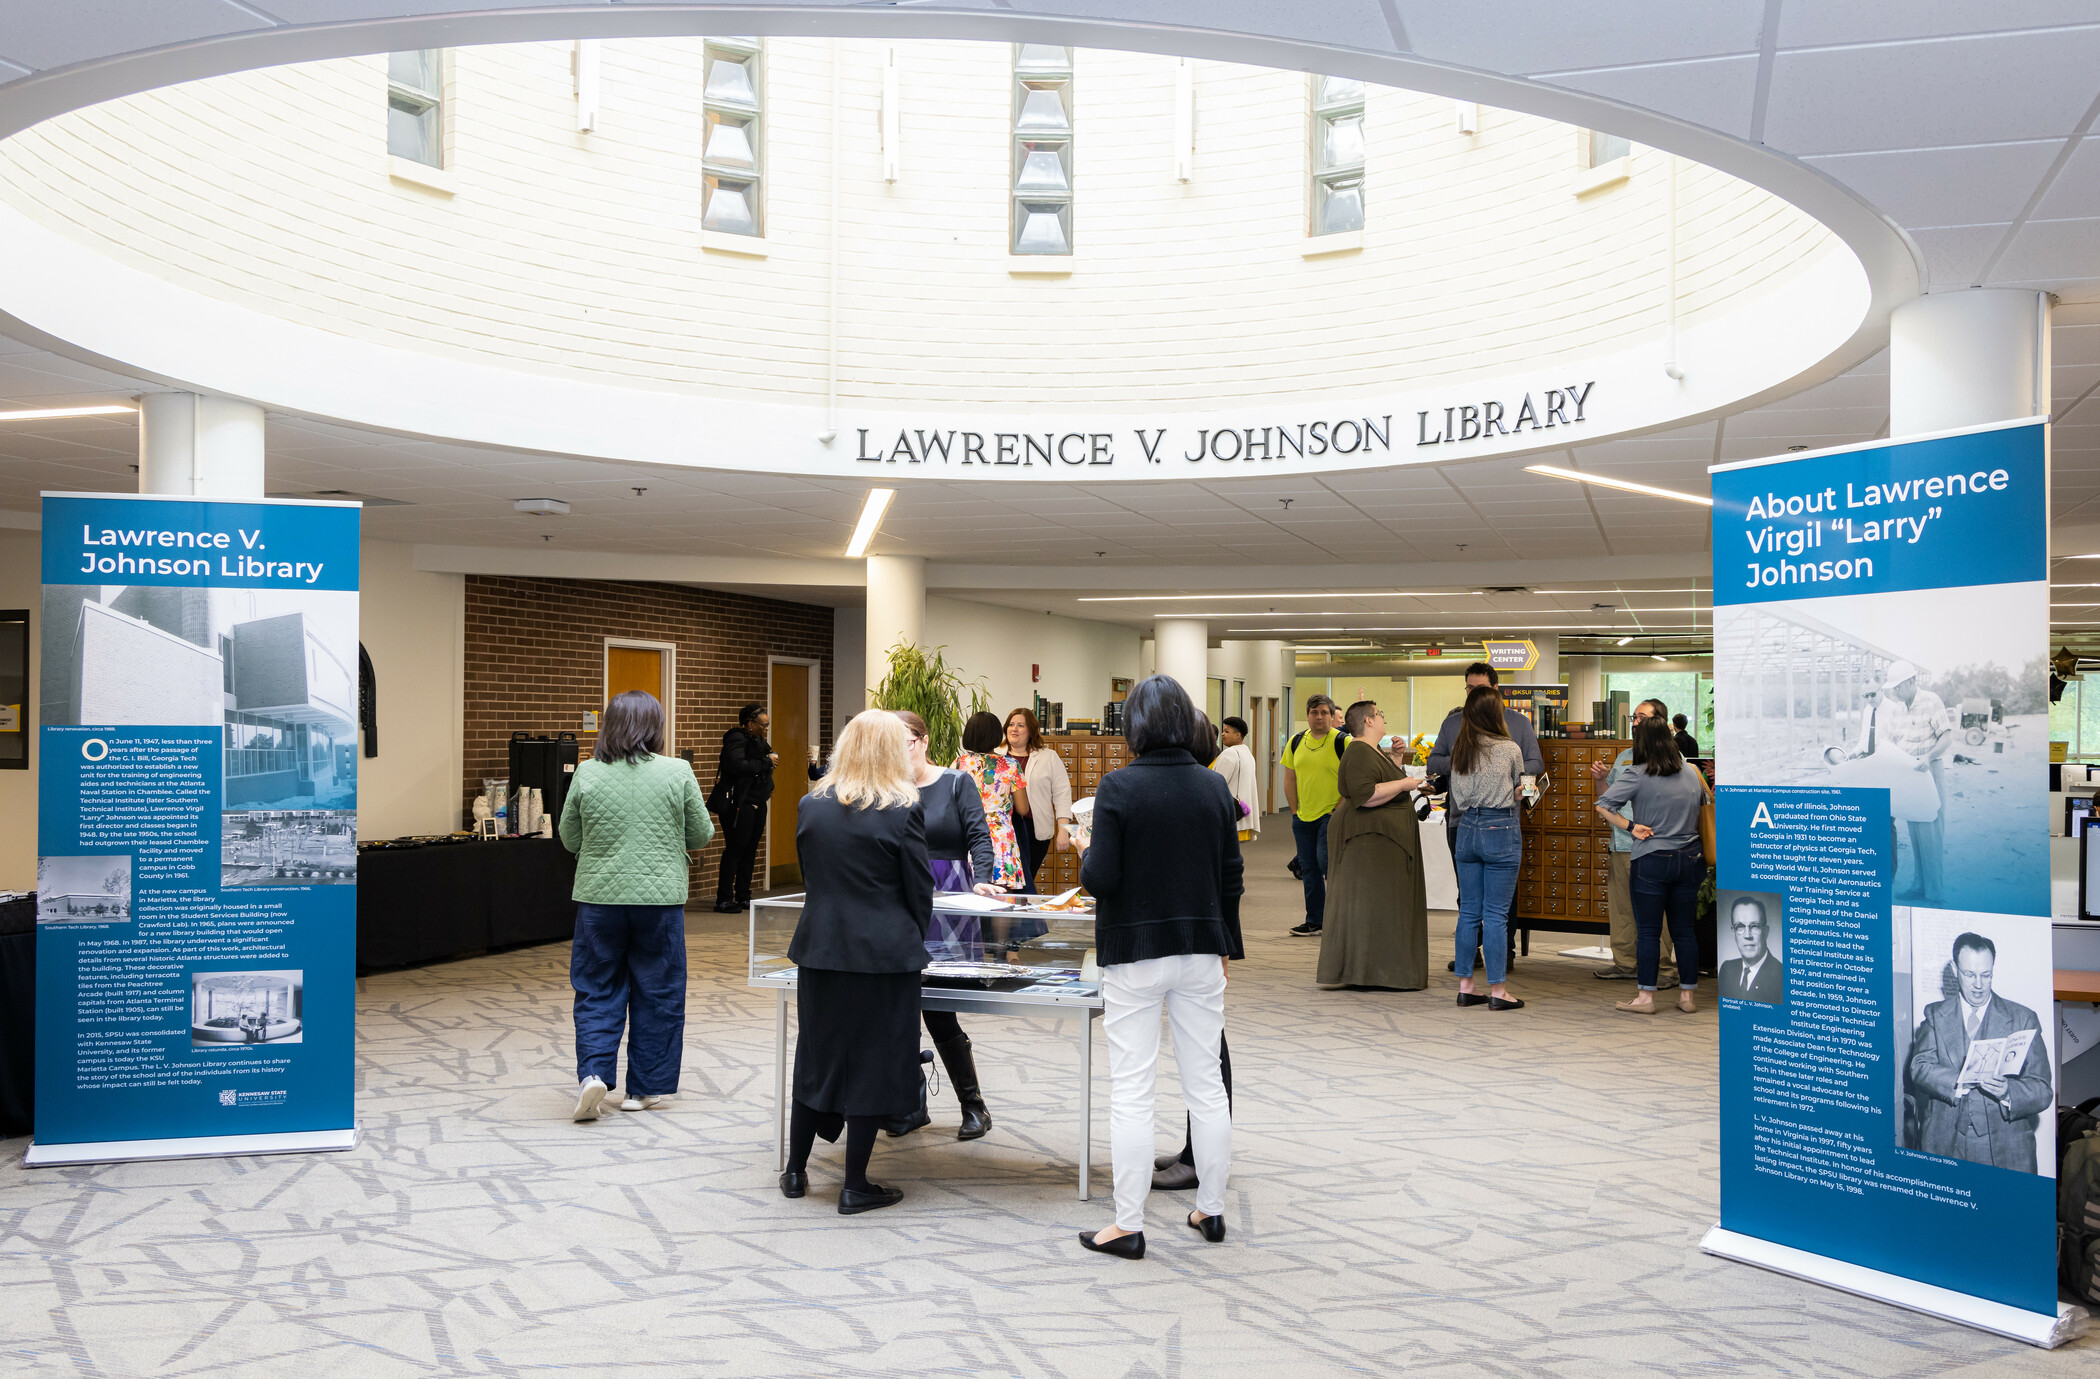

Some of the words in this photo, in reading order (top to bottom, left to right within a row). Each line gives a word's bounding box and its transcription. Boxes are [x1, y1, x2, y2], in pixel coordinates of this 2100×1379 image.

[855, 428, 1115, 467] LAWRENCE
[1133, 428, 1167, 464] V.
[1184, 414, 1393, 462] JOHNSON
[1416, 380, 1596, 447] LIBRARY
[1745, 487, 1836, 521] About
[1846, 468, 2009, 508] Lawrence
[84, 525, 231, 549] Lawrence
[238, 529, 265, 550] V.
[1746, 521, 1821, 556] Virgil
[1831, 507, 1942, 543] “Larry”
[81, 552, 210, 576] Johnson
[221, 555, 324, 584] Library
[1746, 557, 1873, 588] Johnson
[1810, 813, 1828, 821] from
[1751, 842, 1783, 850] instructor
[1792, 844, 1818, 853] physics
[1828, 846, 1856, 855] Georgia
[1857, 847, 1877, 856] Tech,
[1759, 832, 1785, 841] Georgia
[1817, 835, 1846, 843] become
[1750, 852, 1772, 860] where
[1783, 854, 1806, 863] taught
[1789, 916, 1835, 926] Guggenheim
[1836, 920, 1861, 929] School
[1790, 947, 1822, 957] Technical
[1824, 951, 1854, 960] Institute
[1865, 955, 1874, 963] its
[1790, 989, 1817, 998] decade.
[1827, 993, 1845, 1002] 1959,
[1846, 996, 1877, 1006] Johnson
[1753, 1024, 1786, 1035] Extension
[1787, 1029, 1816, 1040] Division,
[1840, 1037, 1857, 1046] 1970
[1858, 1041, 1873, 1049] was
[1753, 1035, 1772, 1043] made
[1773, 1038, 1806, 1049] Associate
[1807, 1043, 1826, 1051] Dean
[1826, 1045, 1837, 1053] for
[1838, 1047, 1880, 1062] Technology
[1754, 1096, 1789, 1108] retirement
[1791, 1101, 1798, 1109] in
[1798, 1103, 1816, 1113] 1972.
[1755, 1164, 1783, 1177] Johnson
[1784, 1171, 1808, 1184] Library
[1820, 1179, 1835, 1190] May
[1836, 1183, 1845, 1192] 15,
[1846, 1185, 1864, 1195] 1998.
